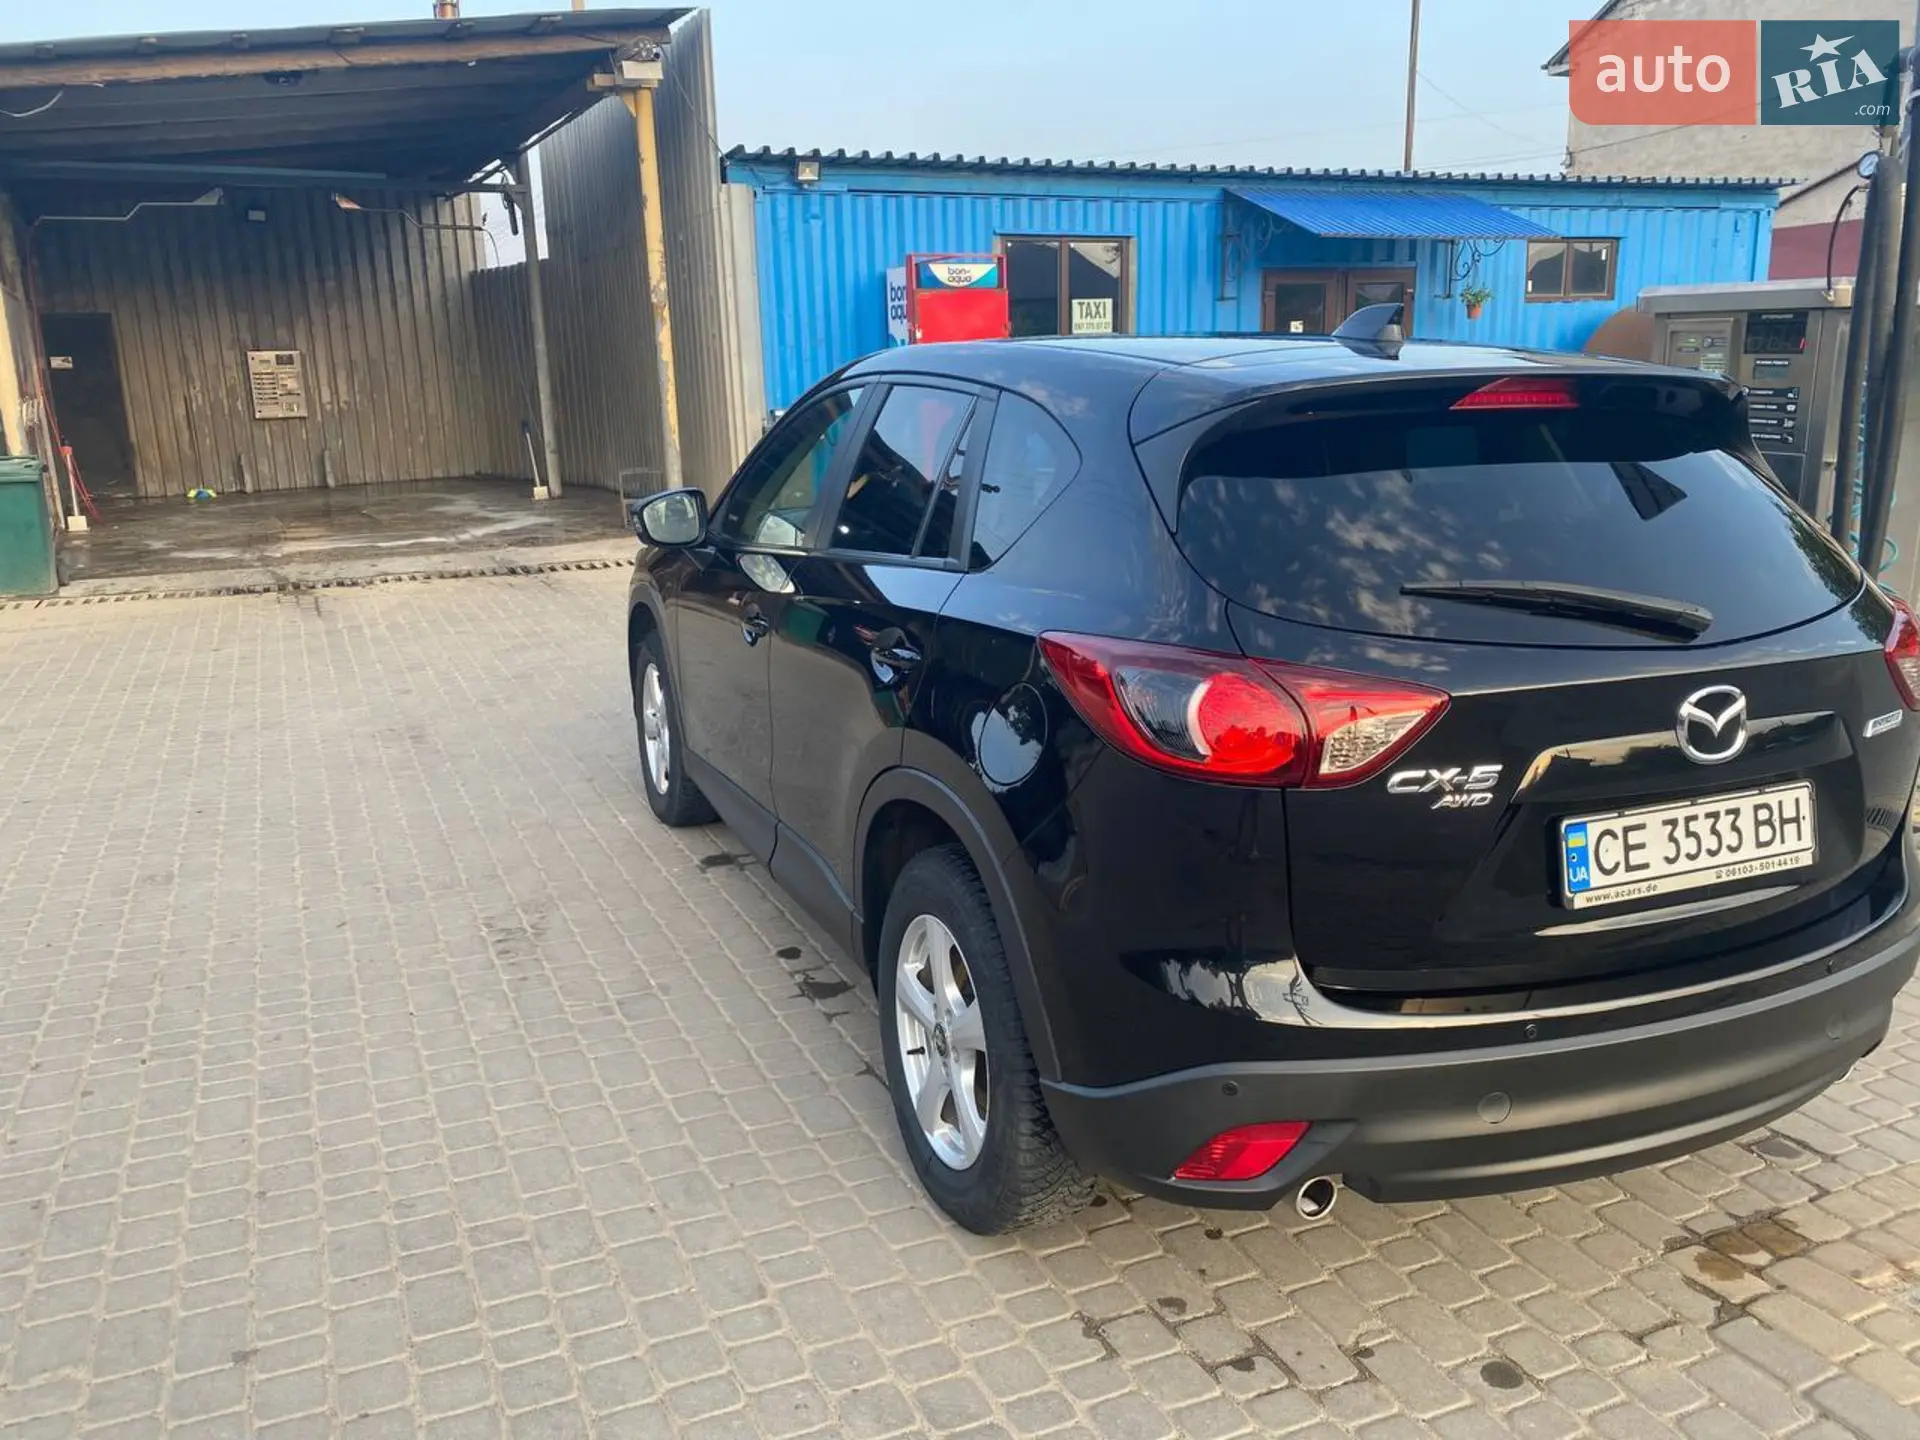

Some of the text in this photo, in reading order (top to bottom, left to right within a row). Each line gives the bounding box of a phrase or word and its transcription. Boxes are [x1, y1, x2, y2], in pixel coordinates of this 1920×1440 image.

[947, 275, 972, 284] aqua
[1077, 301, 1107, 319] TAXI
[1387, 764, 1503, 794] CX-5
[1430, 792, 1493, 810] AWD
[1594, 797, 1802, 876] CE 3533 BH
[1570, 864, 1589, 882] UA
[1585, 882, 1658, 904] www.acars.de
